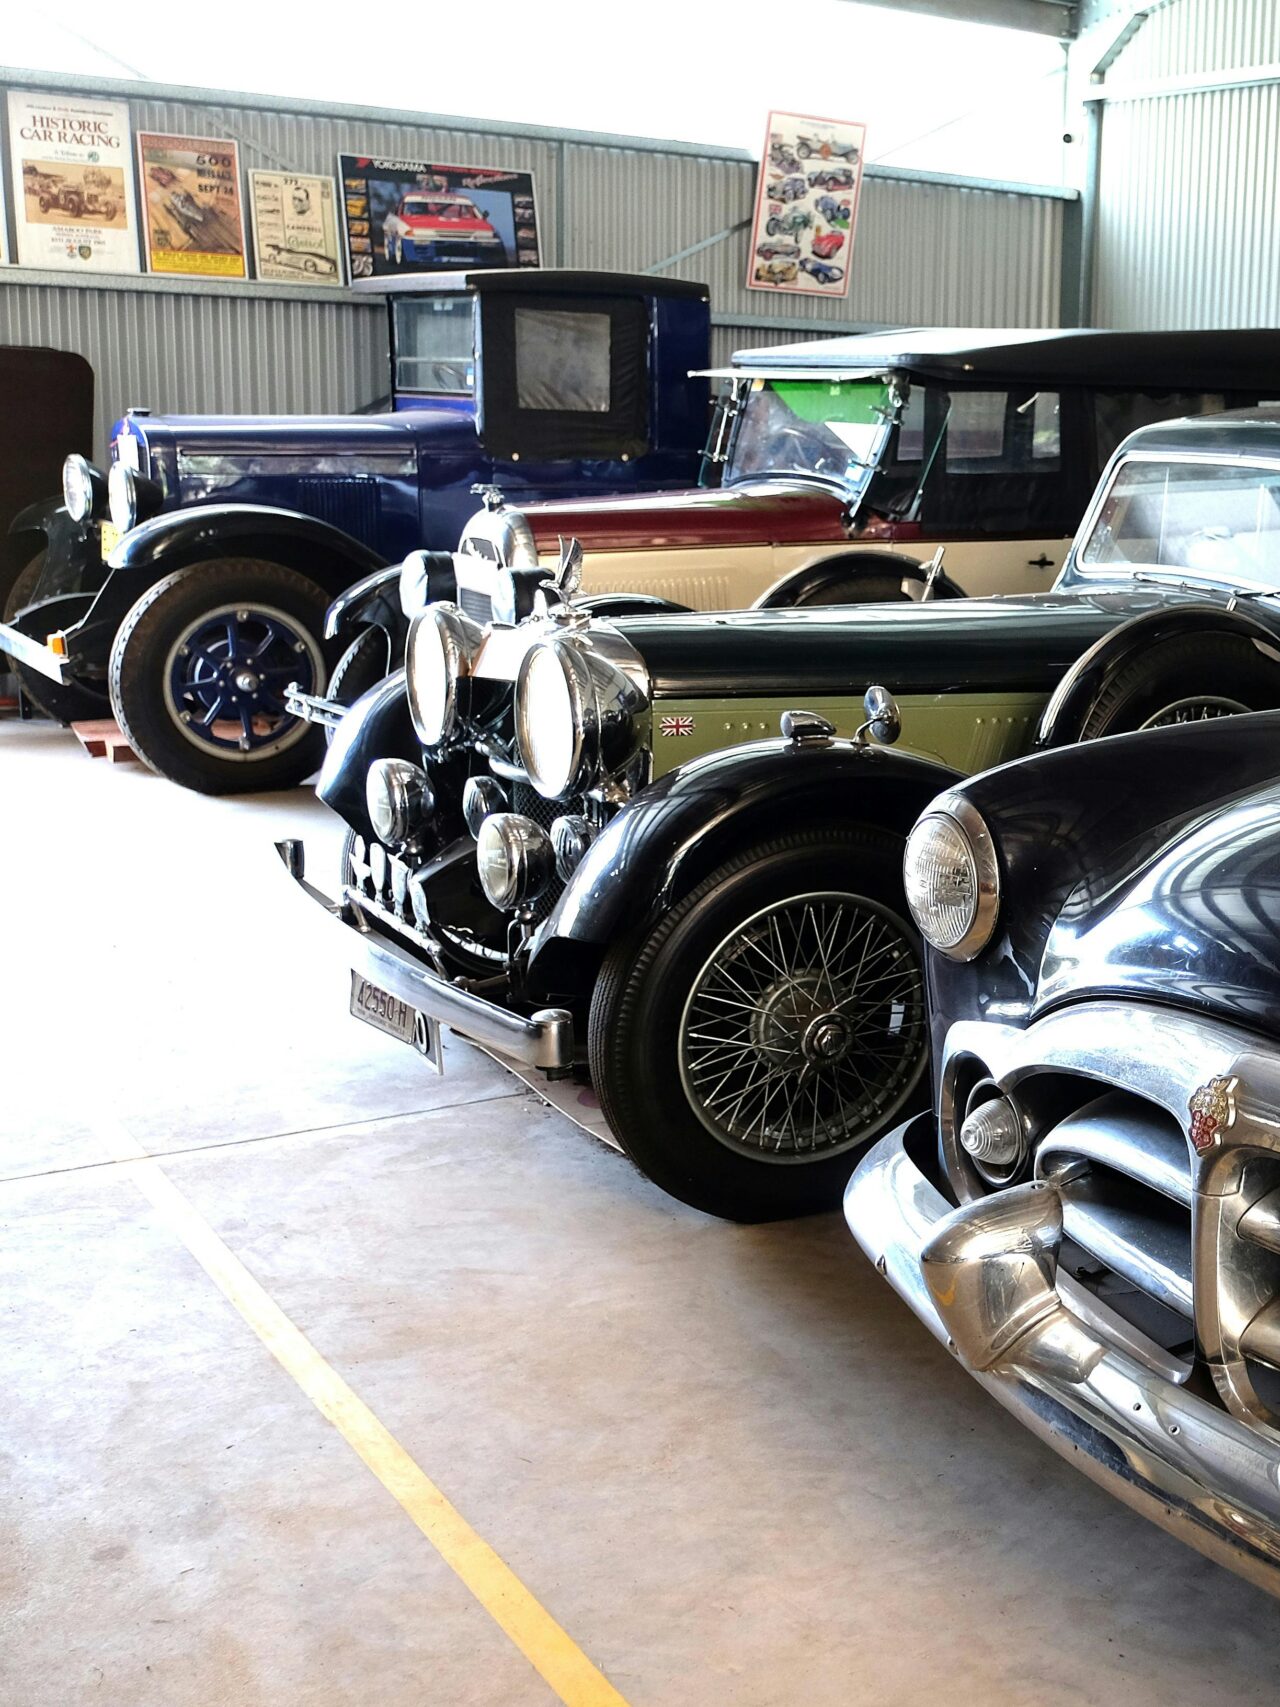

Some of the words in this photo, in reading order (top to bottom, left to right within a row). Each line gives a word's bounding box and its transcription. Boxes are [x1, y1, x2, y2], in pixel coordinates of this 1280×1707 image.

[32, 115, 109, 134] HISTORIC
[20, 127, 53, 141] CAR
[58, 131, 120, 149] RACING
[371, 160, 427, 173] YOKOHAMA
